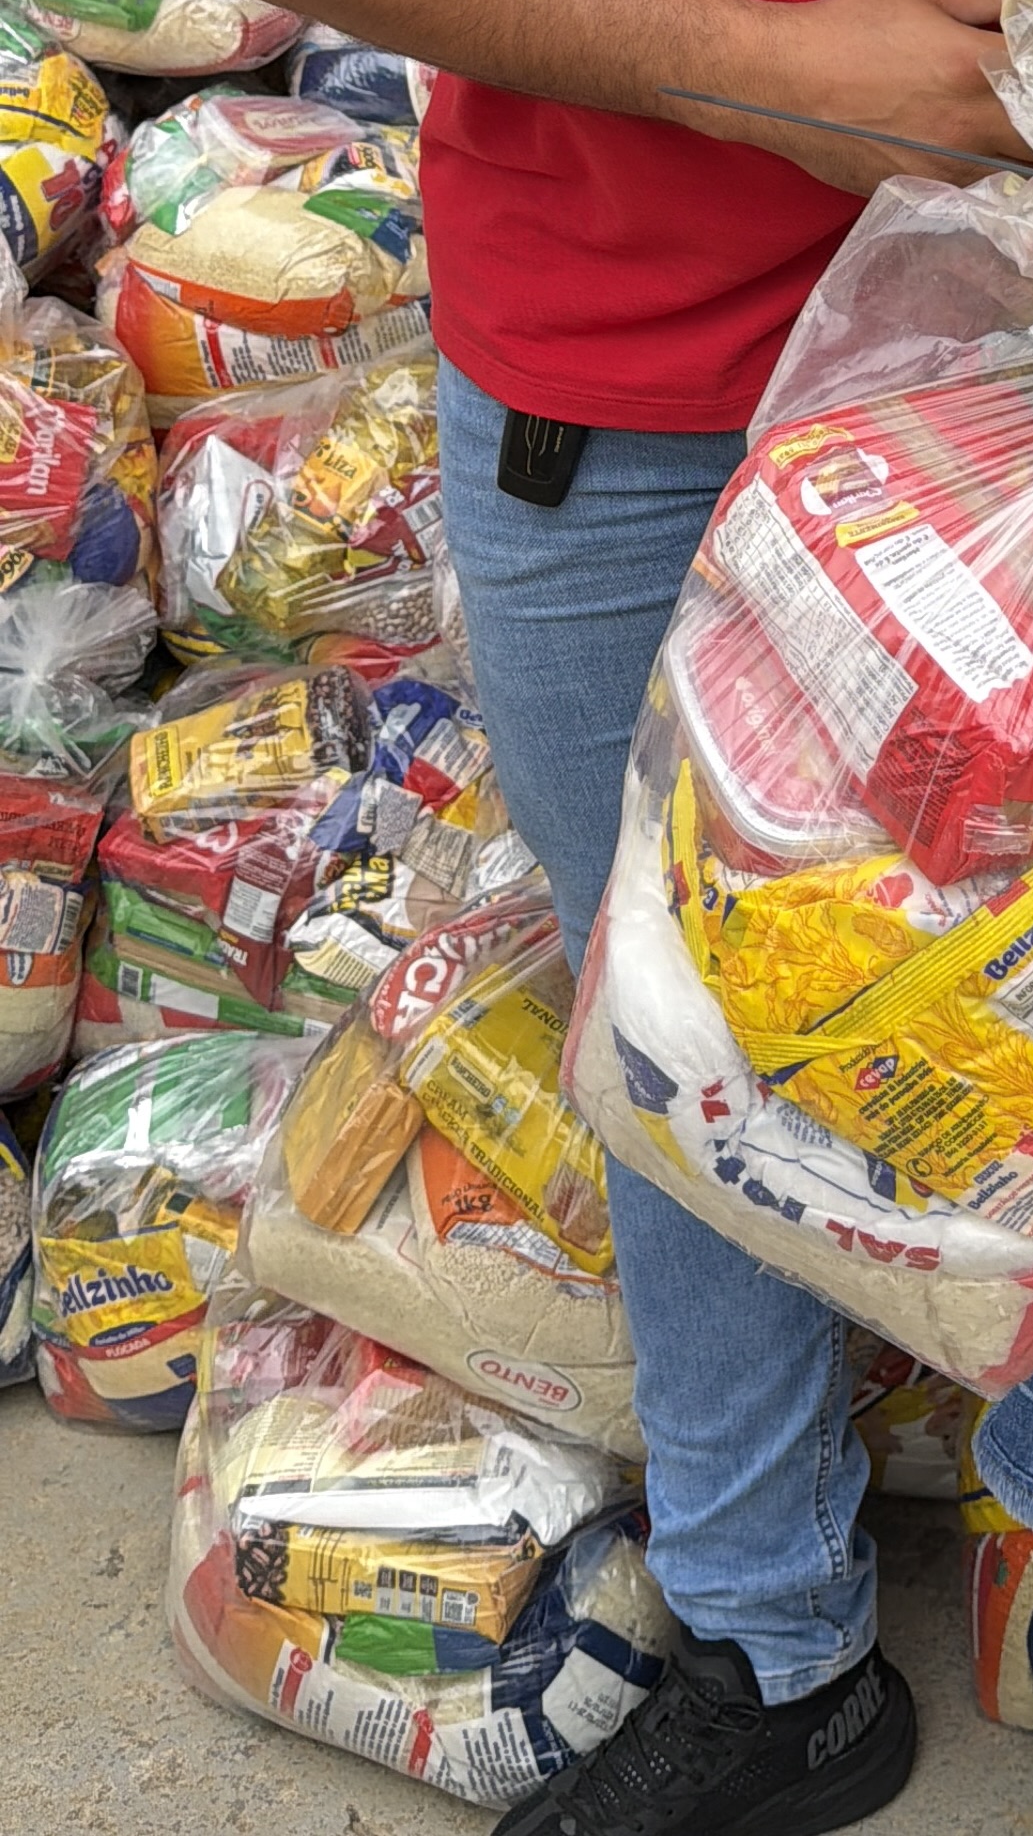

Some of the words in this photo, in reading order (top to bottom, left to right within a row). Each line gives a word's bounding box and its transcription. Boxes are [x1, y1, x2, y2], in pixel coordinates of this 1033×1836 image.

[324, 453, 358, 479] Liza
[859, 1057, 896, 1089] cevap
[469, 1141, 546, 1223] TRADICIONAL
[967, 1170, 1019, 1211] Bellzinho
[825, 1216, 944, 1272] SAL
[481, 1359, 570, 1404] BENTO
